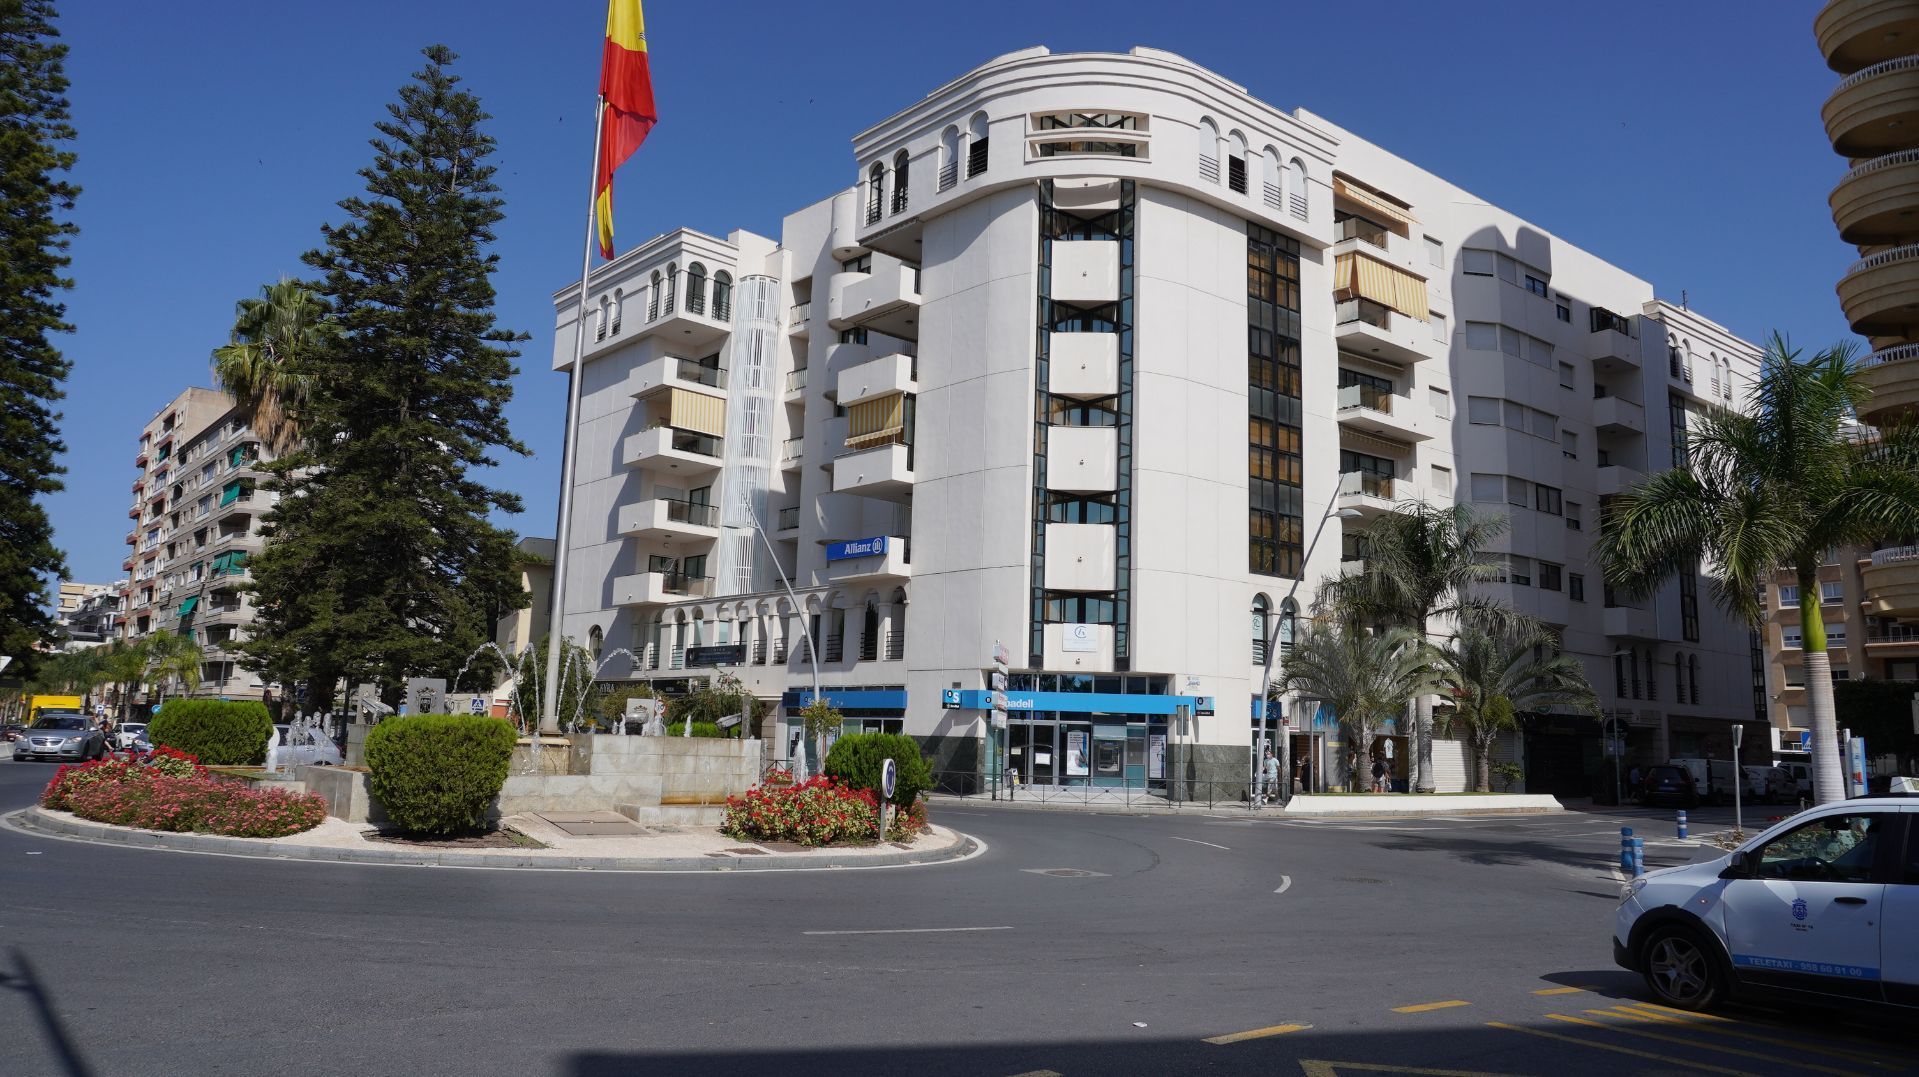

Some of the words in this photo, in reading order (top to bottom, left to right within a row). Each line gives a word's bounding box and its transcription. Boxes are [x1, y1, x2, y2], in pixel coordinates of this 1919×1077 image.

[844, 543, 872, 555] Allianz
[1006, 699, 1034, 709] badell
[1748, 957, 1793, 969] TELETAXI
[1800, 962, 1818, 972] 958
[1834, 966, 1847, 975] 91
[1849, 968, 1863, 977] 00
